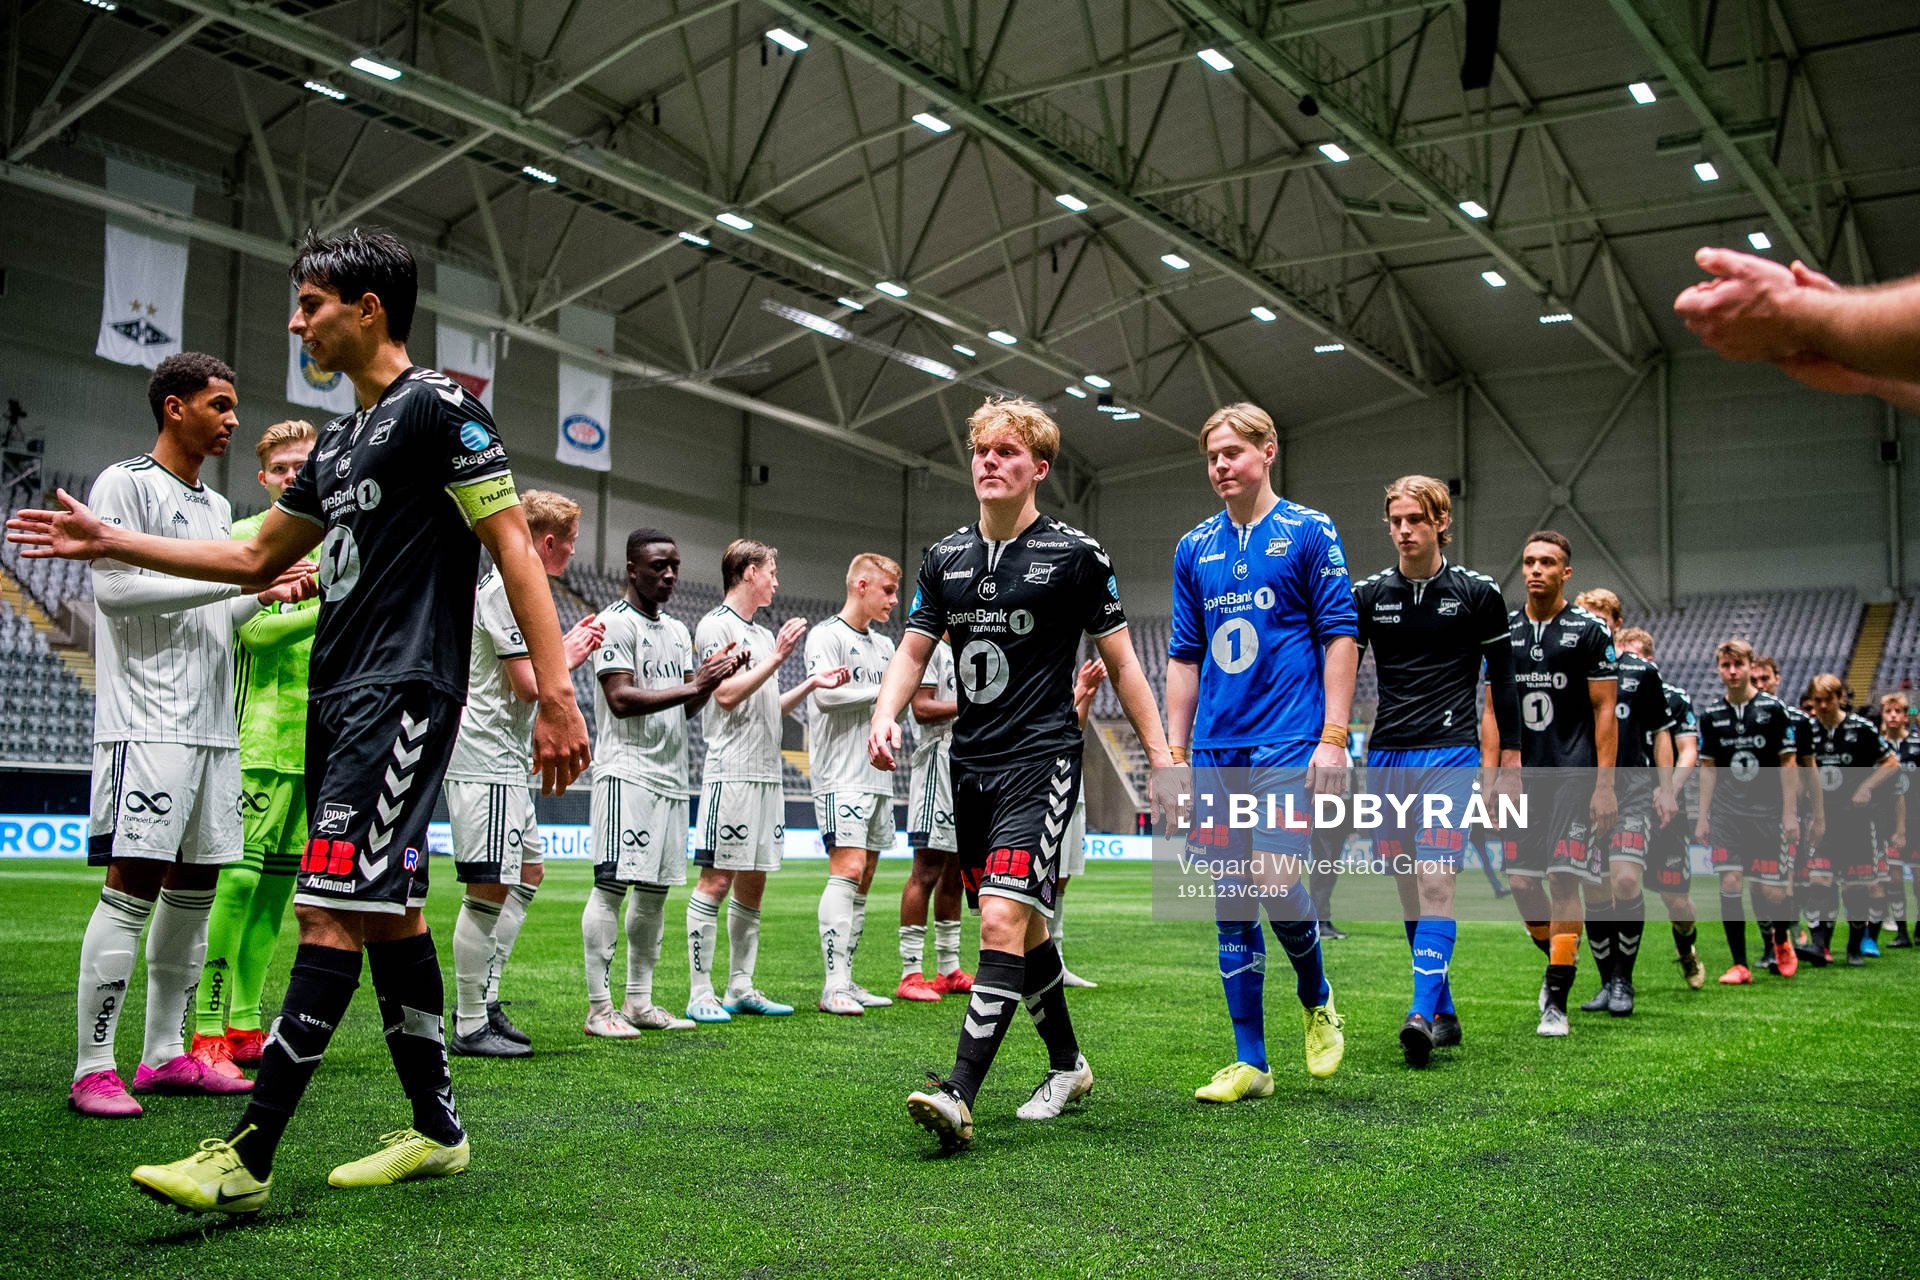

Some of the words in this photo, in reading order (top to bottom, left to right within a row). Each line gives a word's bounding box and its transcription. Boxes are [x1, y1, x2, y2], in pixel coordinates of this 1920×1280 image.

[321, 484, 356, 513] areBank
[1035, 540, 1070, 549] Fjordkraft
[943, 567, 974, 581] hummel
[982, 582, 997, 594] R8
[946, 608, 1008, 625] SpareBank
[969, 624, 1008, 633] TELEMARK
[1515, 671, 1552, 682] pareBank
[1442, 710, 1453, 727] 2
[0, 822, 88, 853] ROS
[1420, 828, 1462, 849] ABB
[1611, 832, 1644, 849] ABB
[404, 847, 419, 871] R
[306, 874, 356, 894] hummel
[990, 873, 1030, 890] hummel
[1218, 942, 1248, 953] arden
[93, 996, 116, 1042] coop
